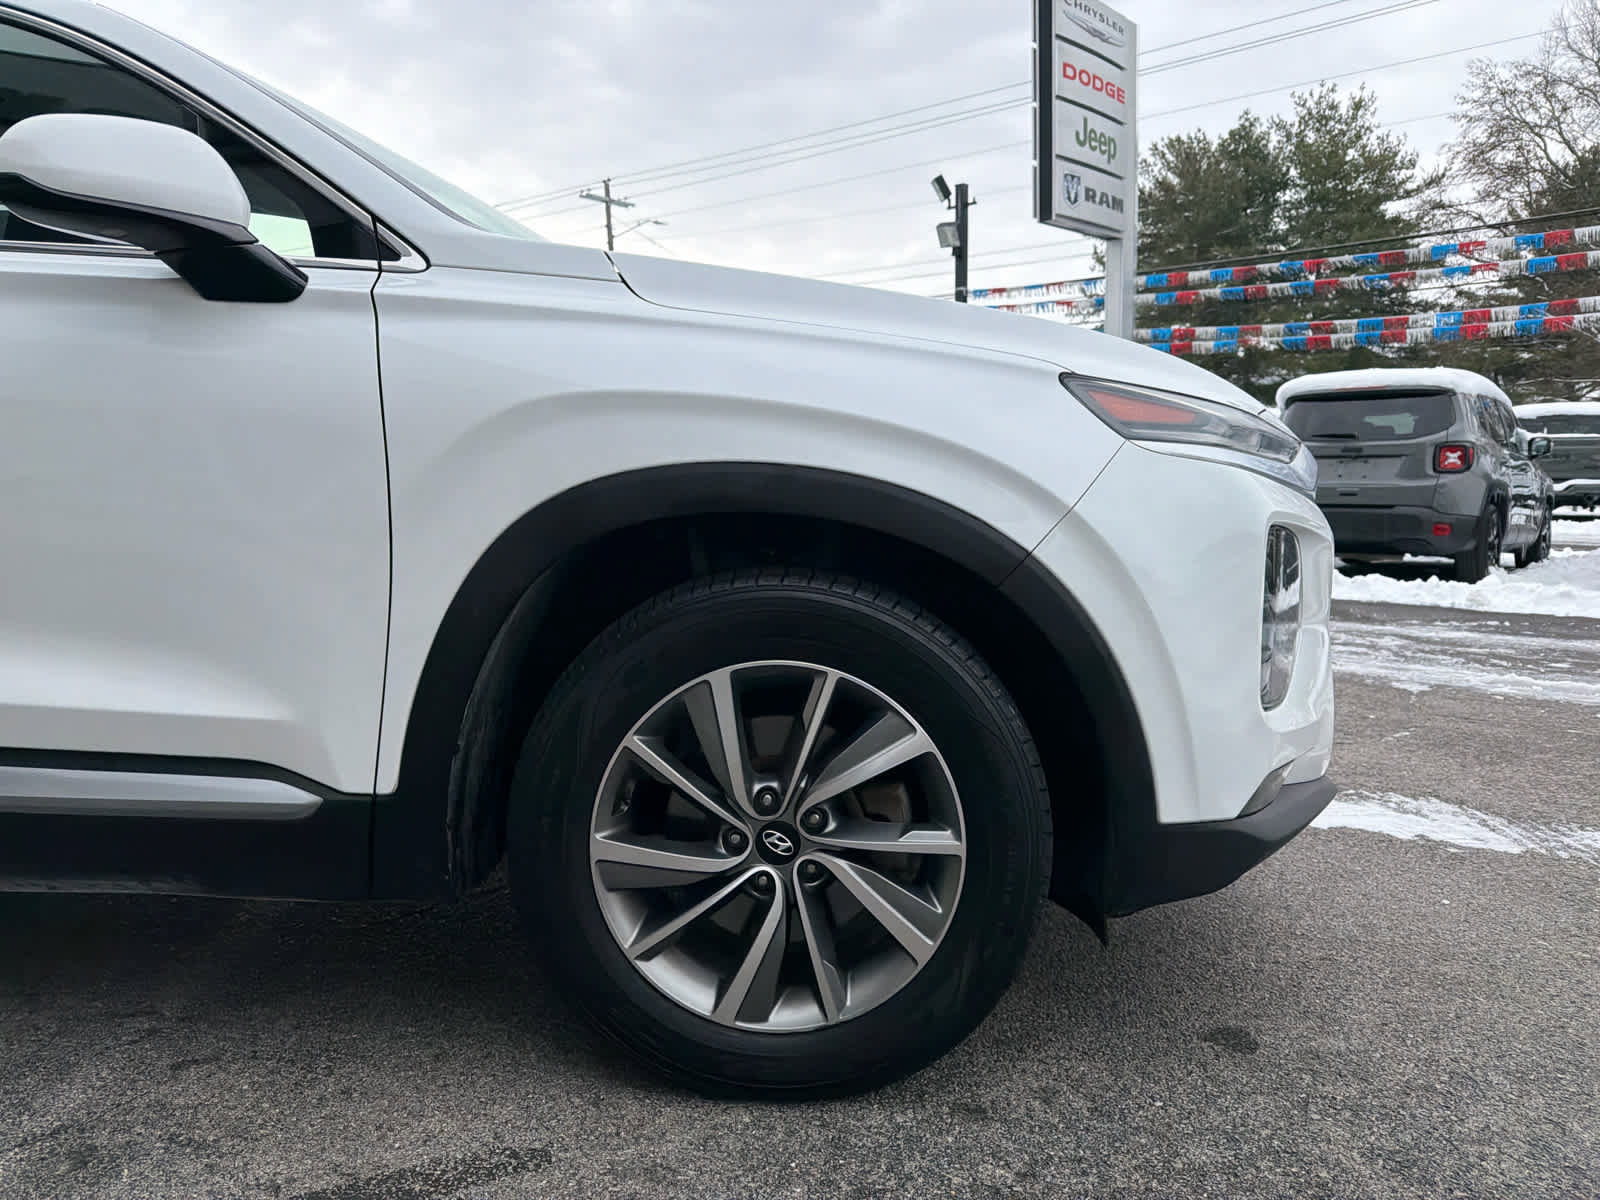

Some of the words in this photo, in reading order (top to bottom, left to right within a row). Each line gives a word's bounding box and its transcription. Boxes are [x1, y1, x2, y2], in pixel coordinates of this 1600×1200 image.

[1062, 62, 1126, 104] DODGE
[1075, 117, 1118, 164] Jeep
[1084, 186, 1124, 213] RAM
